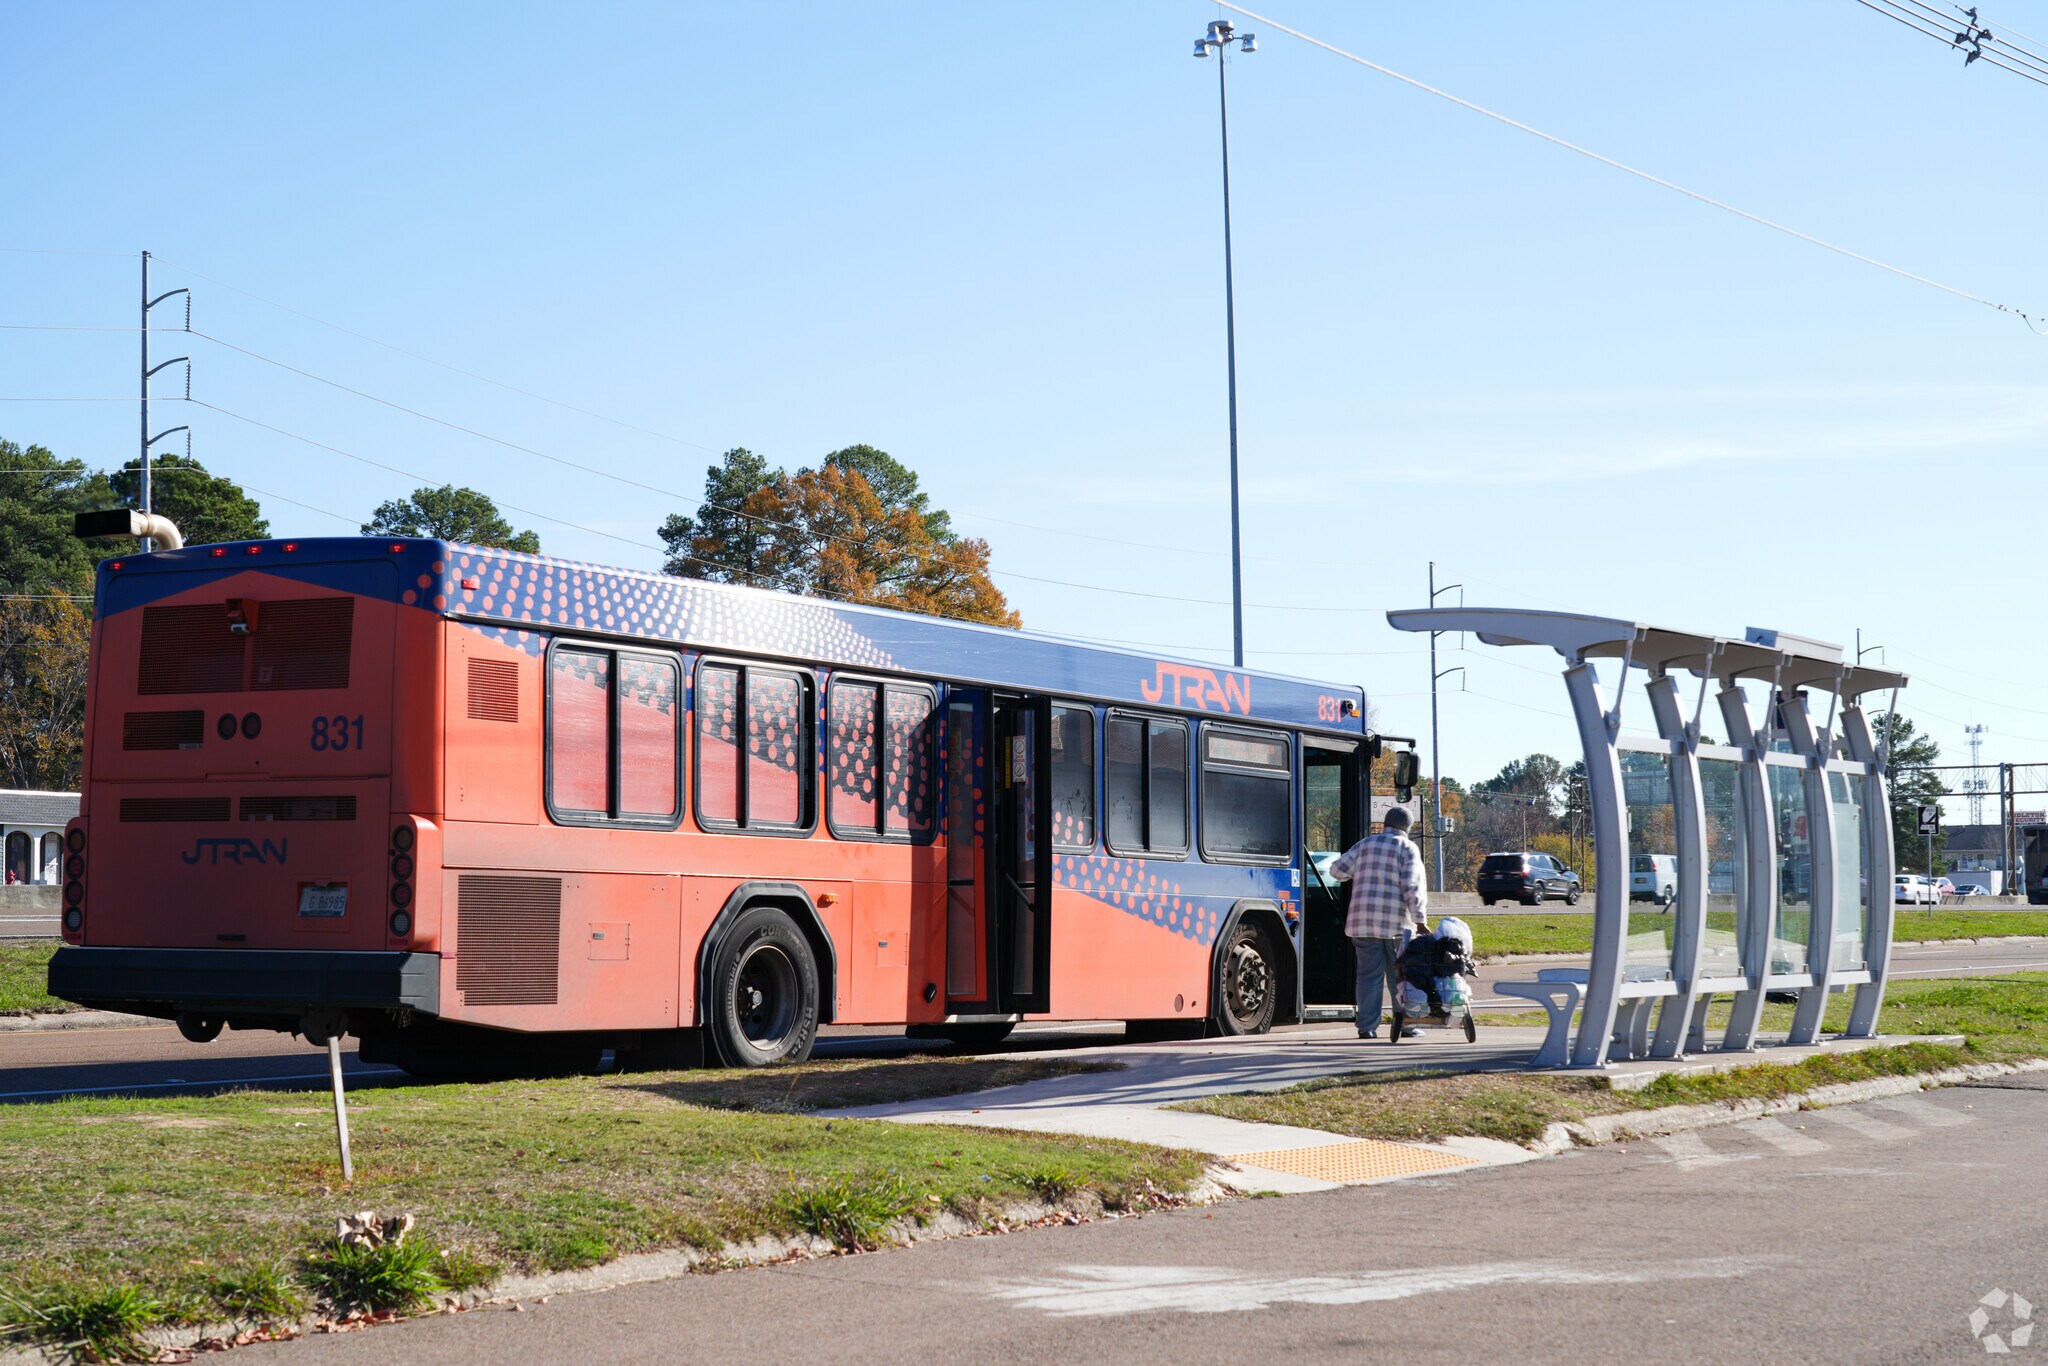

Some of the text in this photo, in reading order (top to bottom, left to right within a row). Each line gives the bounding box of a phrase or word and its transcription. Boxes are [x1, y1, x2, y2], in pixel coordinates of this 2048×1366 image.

[1141, 660, 1250, 715] JTRAN
[1318, 694, 1342, 723] 831
[311, 714, 365, 752] 831
[181, 837, 288, 865] JTRAN
